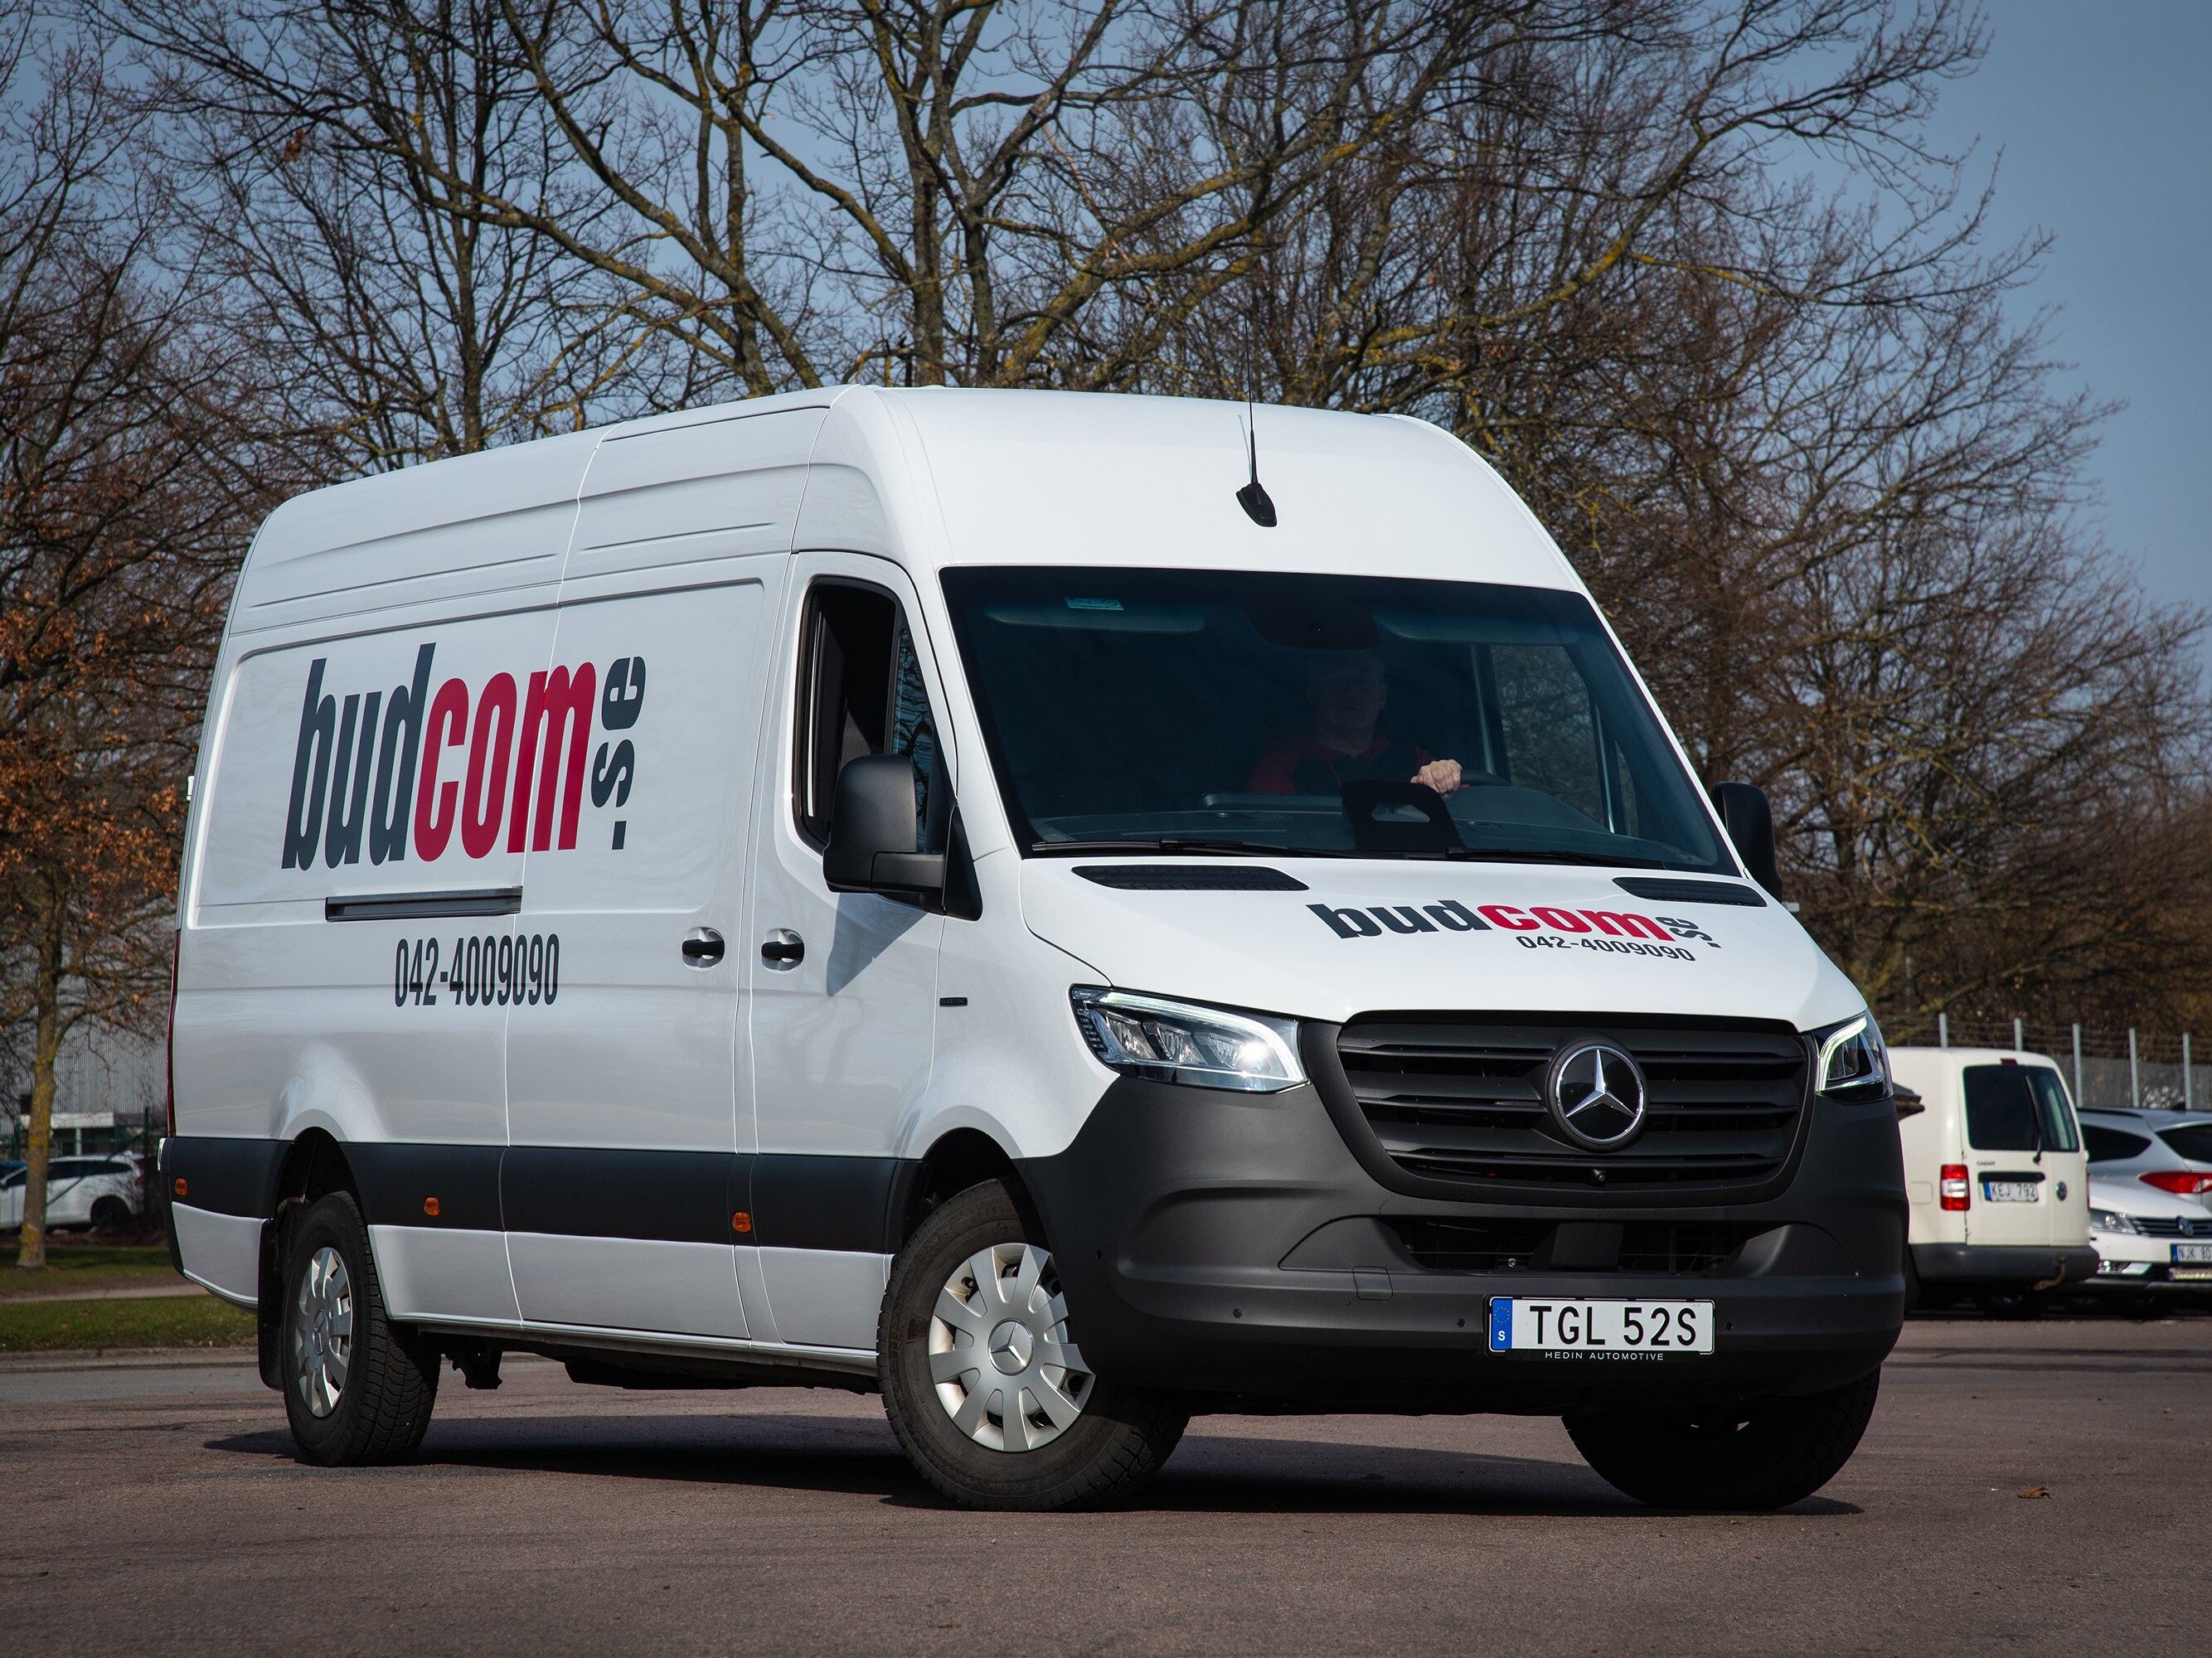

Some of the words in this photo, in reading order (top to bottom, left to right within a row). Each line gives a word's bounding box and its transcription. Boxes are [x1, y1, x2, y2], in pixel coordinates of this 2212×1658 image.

[280, 642, 597, 871] budcom
[1306, 899, 1676, 942] budcom
[1516, 936, 1696, 962] 042-4009090
[395, 933, 560, 1008] 042-4009090
[1497, 1331, 1506, 1341] S
[1530, 1306, 1607, 1345] TGL
[1623, 1307, 1696, 1346] 52S
[1545, 1351, 1584, 1360] HEDIN
[1589, 1352, 1664, 1361] AUTOMOTIVE
